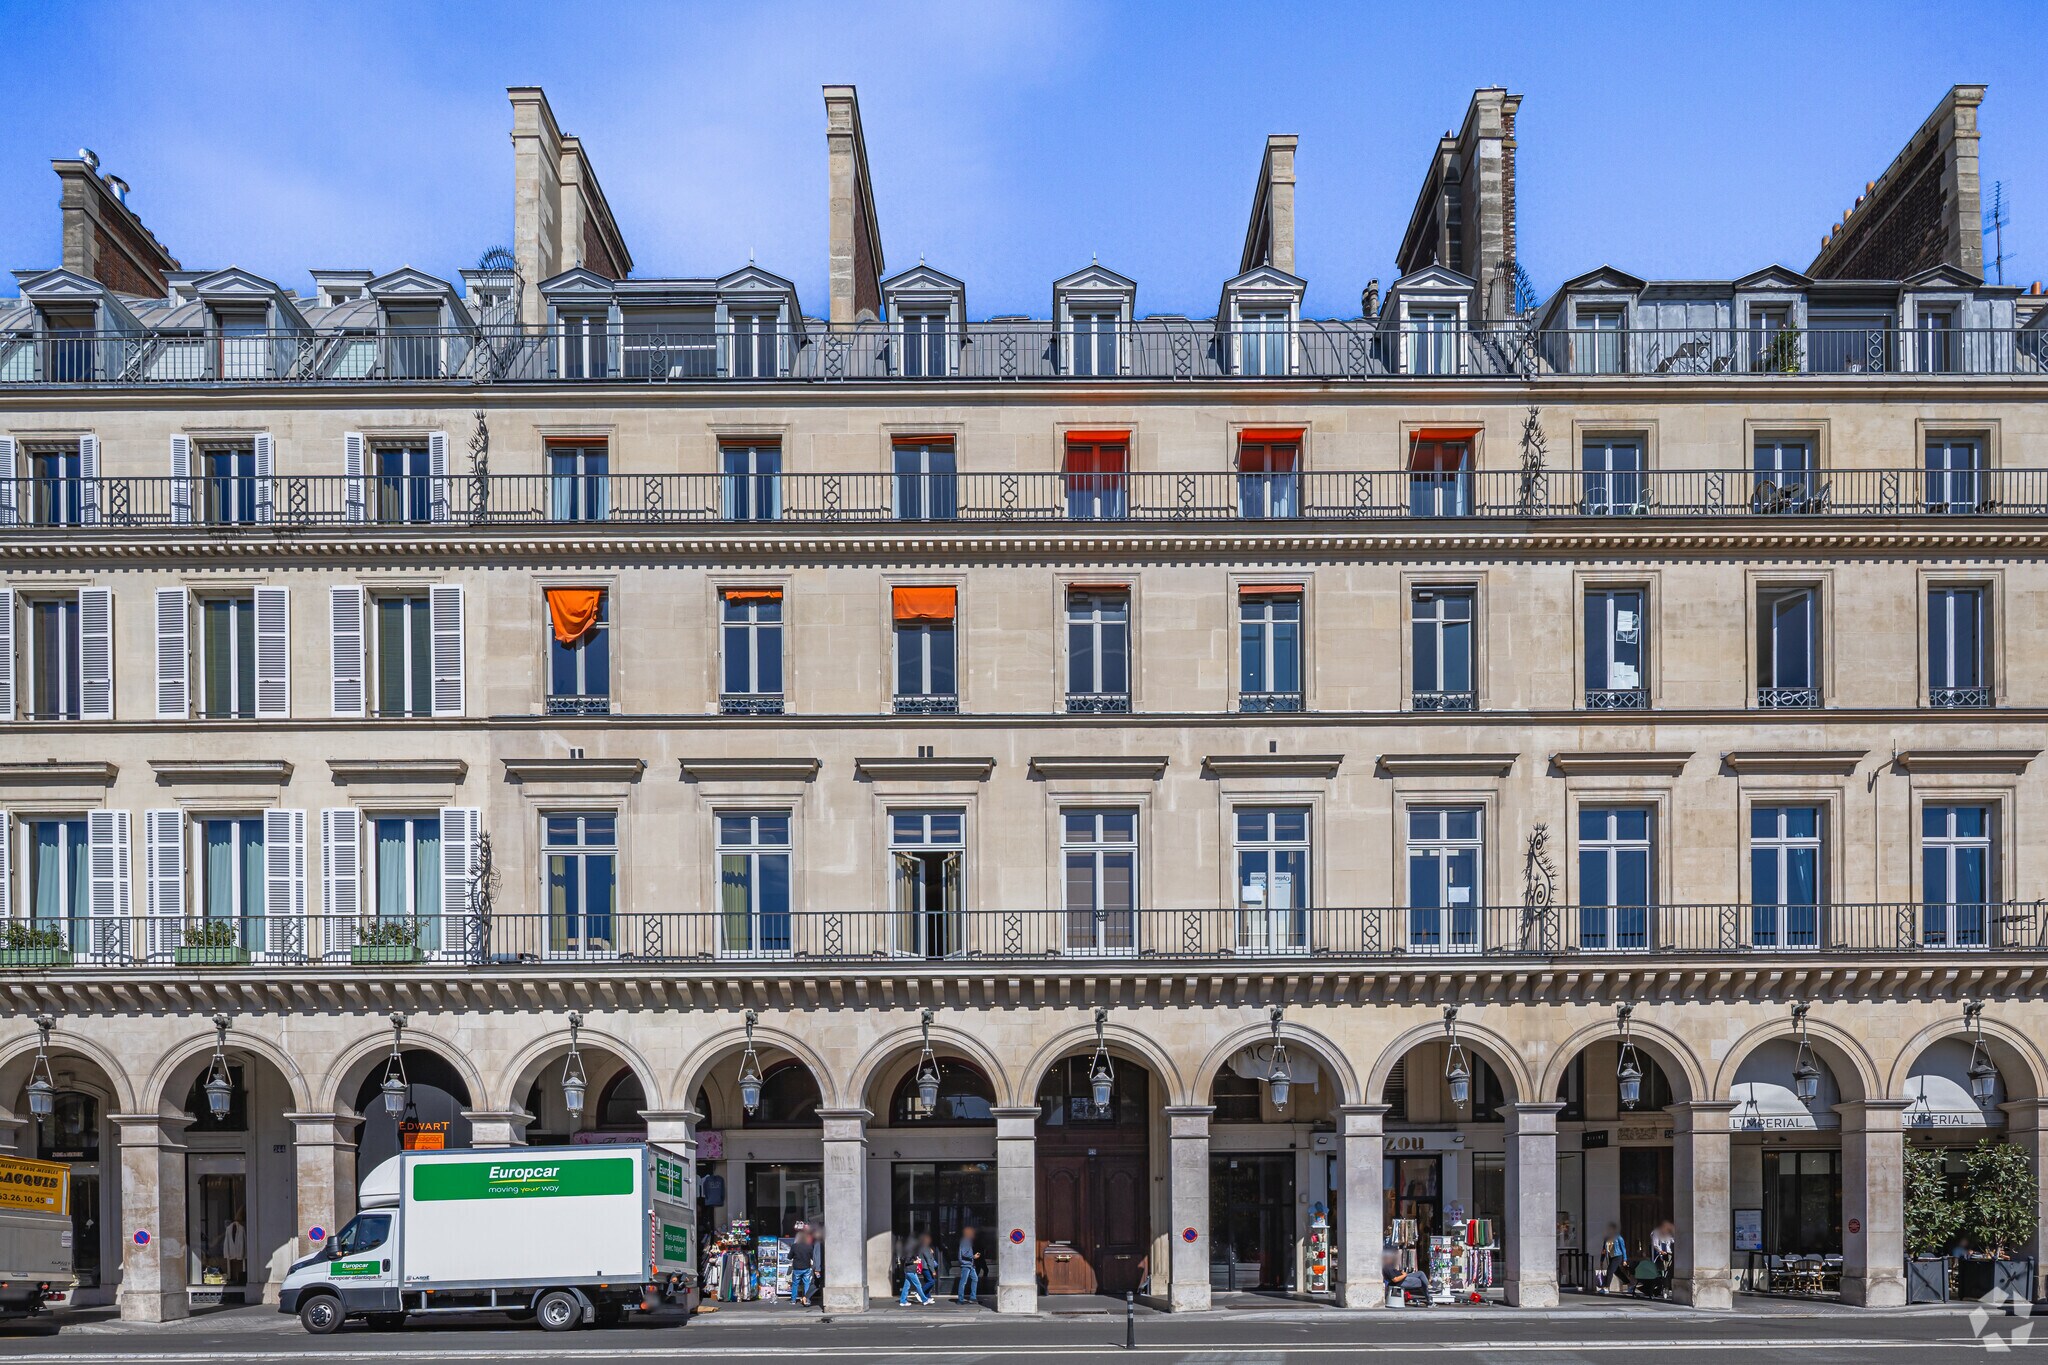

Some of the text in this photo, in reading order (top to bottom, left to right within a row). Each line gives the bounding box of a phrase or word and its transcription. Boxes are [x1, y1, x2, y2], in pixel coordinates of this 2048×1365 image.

[1732, 1117, 1803, 1129] L'IMPERIAL
[1903, 1114, 1968, 1125] 'IMPERIAL
[399, 1121, 450, 1131] EDWART
[0, 1171, 58, 1188] ACQUIS
[489, 1166, 560, 1182] Europcar
[488, 1185, 560, 1194] moving your way
